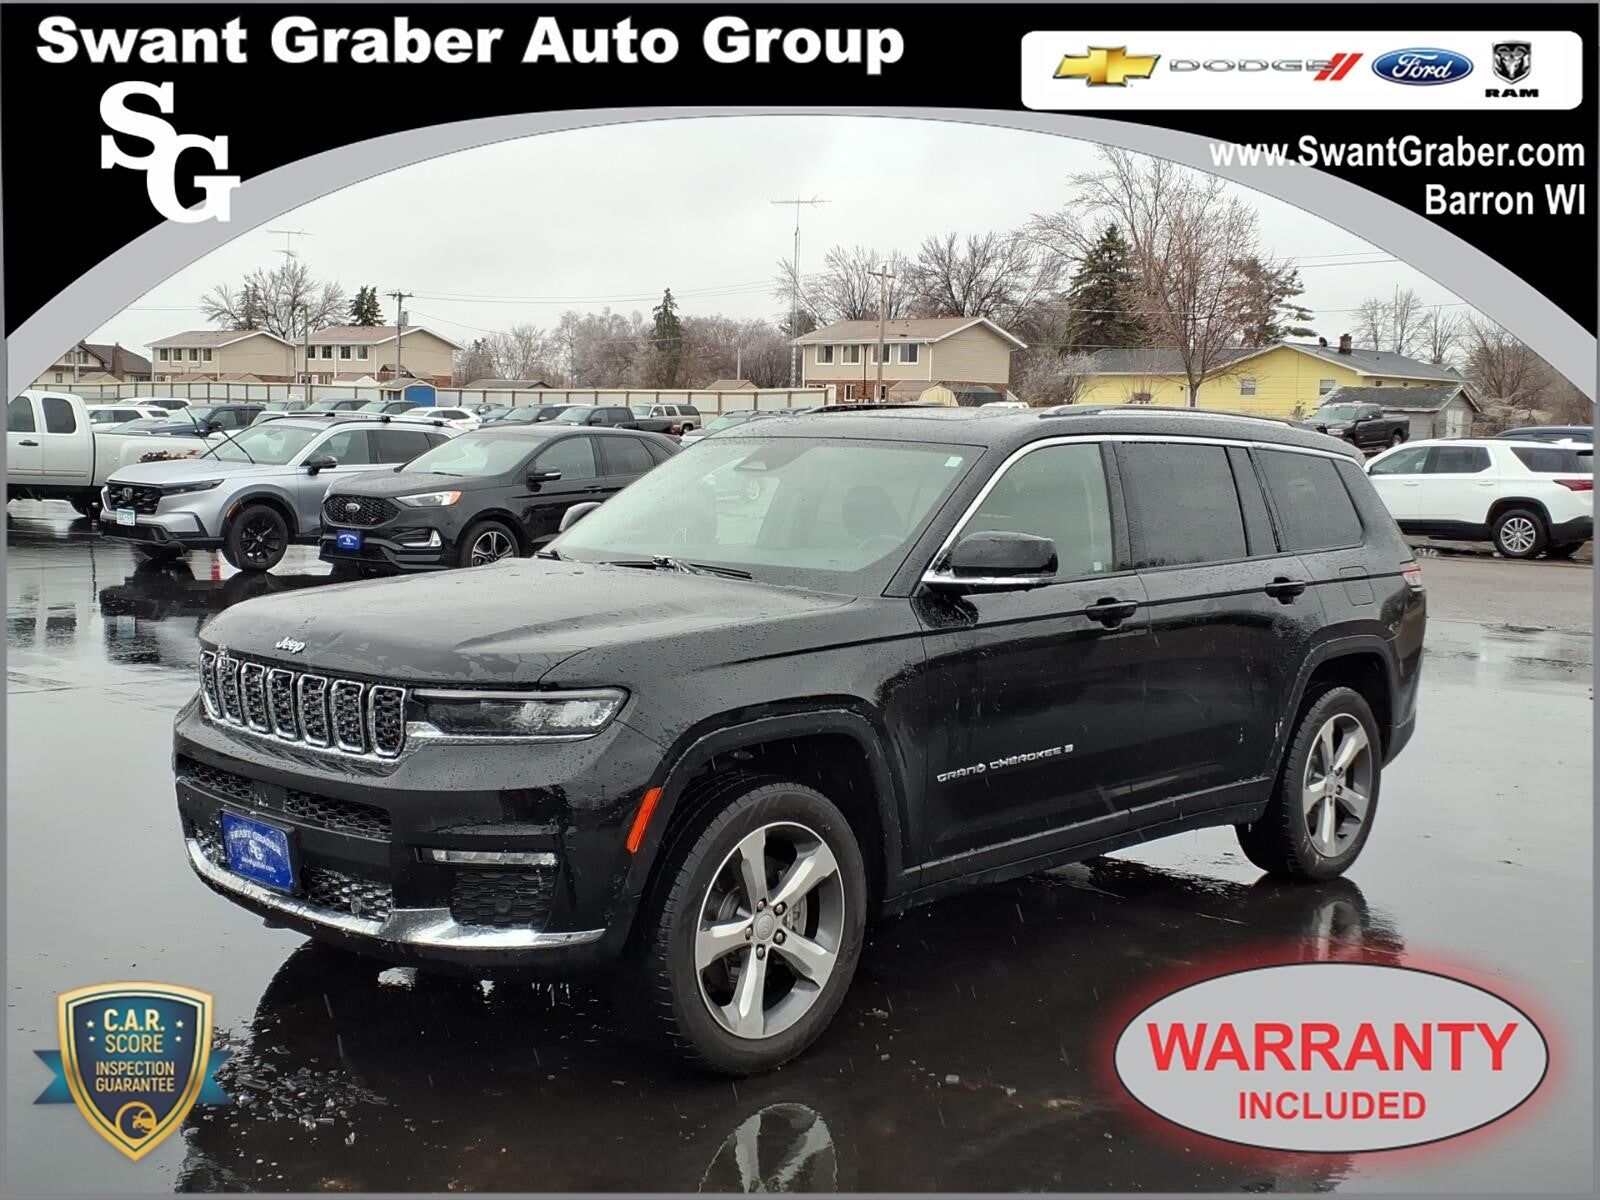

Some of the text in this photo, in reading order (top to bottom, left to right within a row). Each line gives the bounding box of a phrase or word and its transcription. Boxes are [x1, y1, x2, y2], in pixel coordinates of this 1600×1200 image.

[275, 637, 306, 654] Jeep
[937, 763, 987, 782] GRAND
[990, 747, 1062, 770] CHEROKEE
